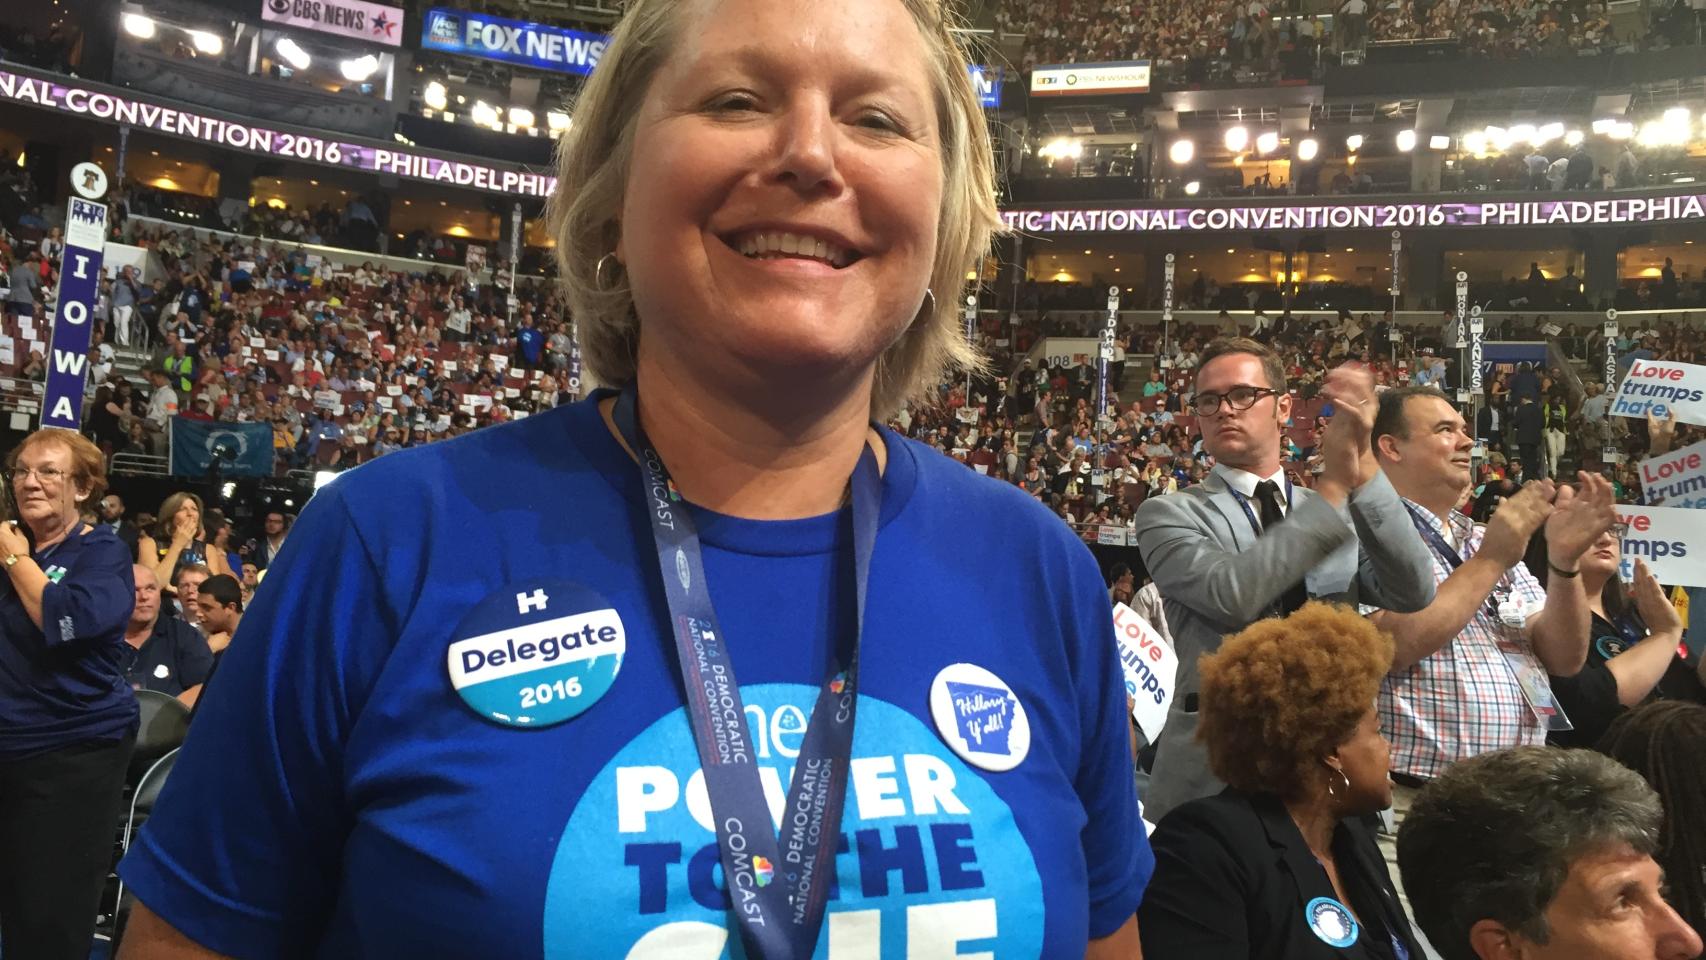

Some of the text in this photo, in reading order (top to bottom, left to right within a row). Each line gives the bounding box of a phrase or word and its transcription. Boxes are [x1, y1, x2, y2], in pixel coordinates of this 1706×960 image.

[292, 0, 365, 31] CBS NEWS
[465, 20, 607, 68] FOX NEWS
[0, 73, 57, 107] NAL
[65, 88, 273, 152] CONVENTION
[278, 133, 342, 164] 2016
[1050, 210, 1182, 231] NATIONAL
[1187, 206, 1374, 230] CONVENTION
[1382, 204, 1446, 227] 2016
[1481, 195, 1706, 225] PHILADELPHIA
[50, 254, 91, 421] IOWA
[1457, 295, 1466, 343] MONTANA
[1471, 333, 1482, 388] KANSAS
[1605, 337, 1617, 393] ALASKA
[1631, 362, 1685, 382] Love
[1622, 378, 1704, 403] trumps
[644, 448, 675, 531] COMCAST
[1643, 452, 1702, 484] Love
[461, 623, 618, 675] Delegate
[1113, 608, 1163, 662] Love
[518, 675, 583, 709] 2016
[687, 616, 733, 765] NATIONAL CONVENTION
[1117, 639, 1166, 705] umps
[712, 663, 748, 765] DEMOCRATIC
[955, 693, 1008, 717] Hillary
[787, 758, 822, 864] DEMOCRATIC
[793, 757, 833, 925] NATIONAL CONVENTION
[724, 817, 766, 927] COMCAST
